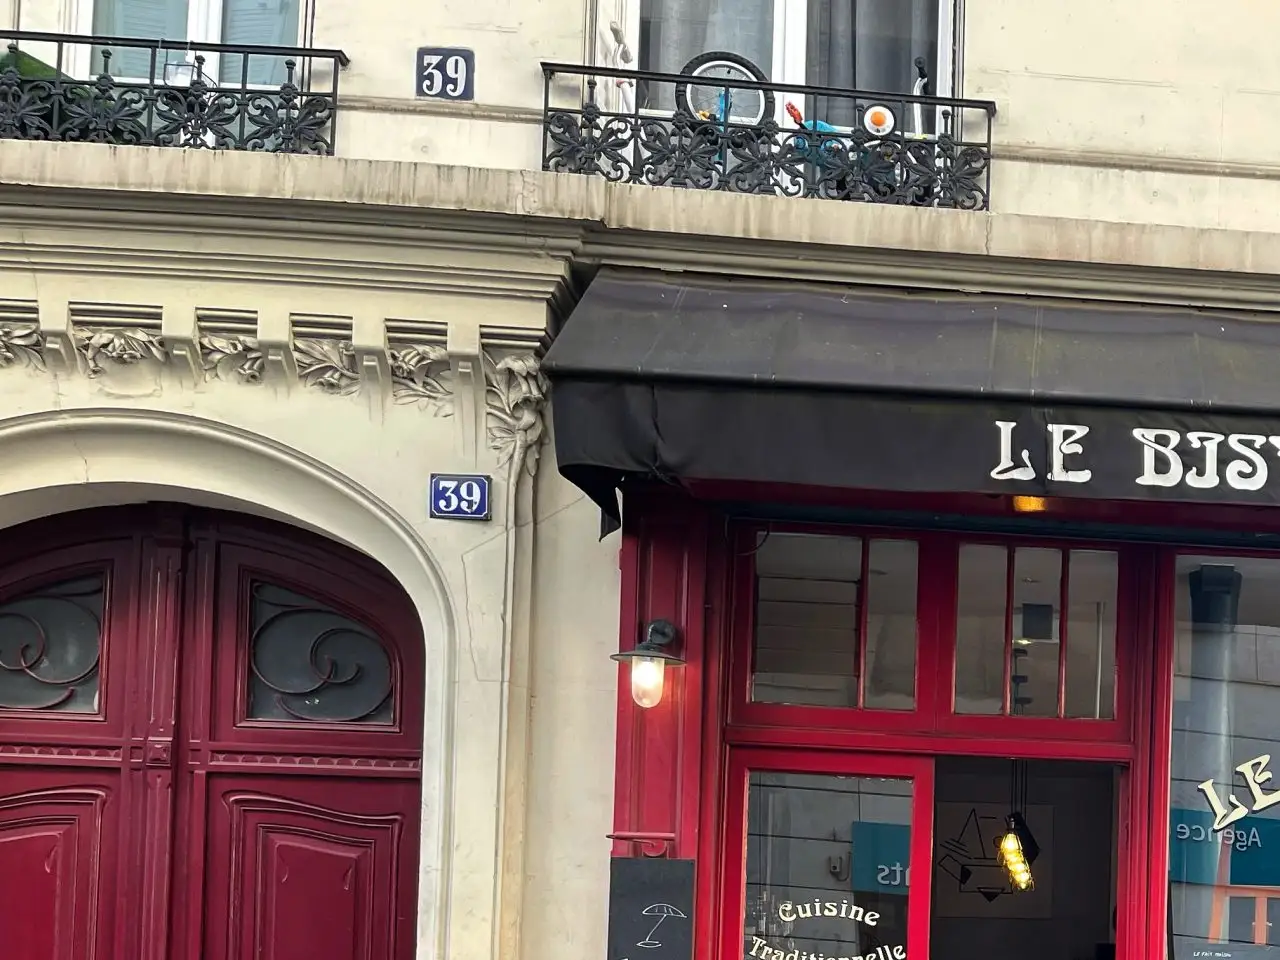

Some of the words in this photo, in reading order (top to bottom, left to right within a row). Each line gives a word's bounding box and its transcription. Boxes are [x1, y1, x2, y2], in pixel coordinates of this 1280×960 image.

[422, 54, 467, 97] 39
[990, 420, 1092, 483] LE
[438, 480, 481, 513] 39
[778, 898, 881, 927] Cuisine
